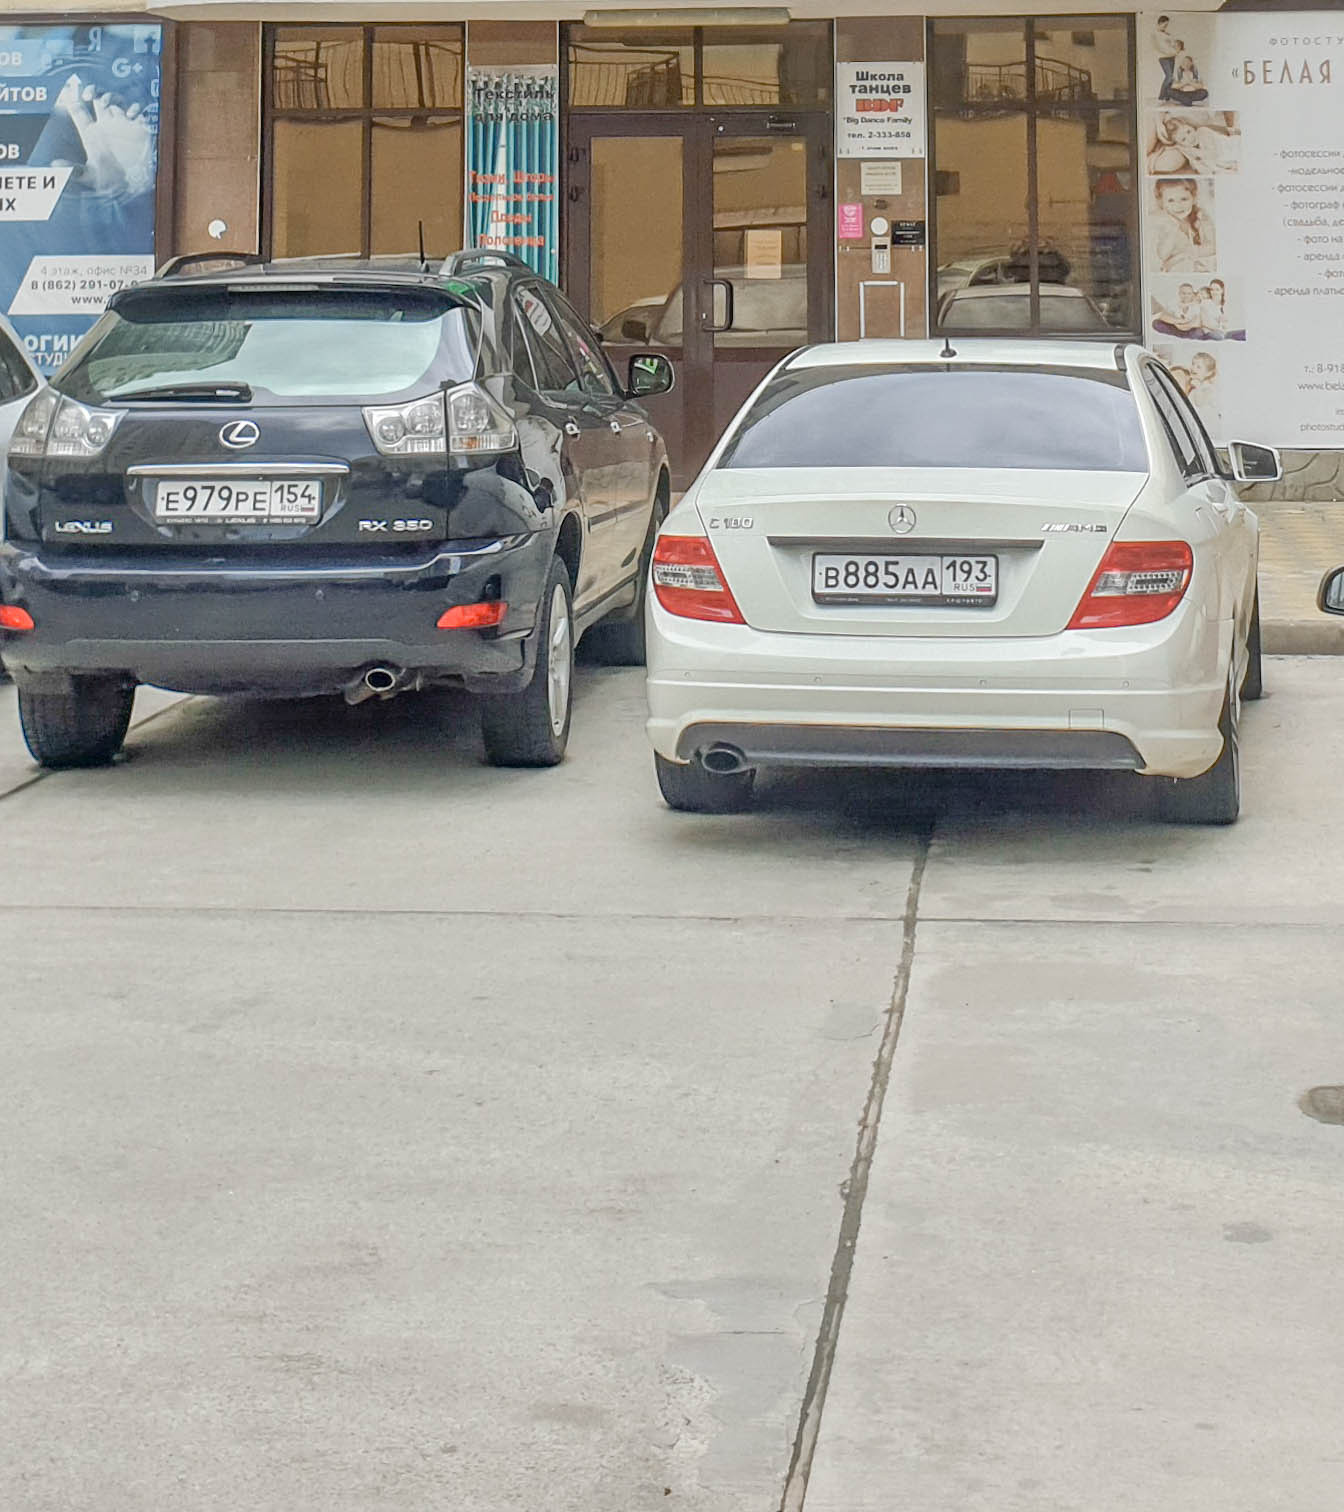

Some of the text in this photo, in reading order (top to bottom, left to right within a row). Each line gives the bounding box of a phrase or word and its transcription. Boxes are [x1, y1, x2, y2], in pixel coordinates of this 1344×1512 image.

[855, 71, 905, 82] Школа
[1231, 58, 1332, 86] «БЕЛАЯ
[849, 84, 912, 96] танцев
[42, 175, 56, 190] И
[31, 279, 139, 291] 8 (862) 291-07-9
[165, 483, 313, 512] Е979РЕ 154
[55, 520, 113, 533] LEXUS
[358, 519, 433, 532] RX 350
[824, 559, 988, 590] В885АА 193
[953, 583, 976, 592] RUS
